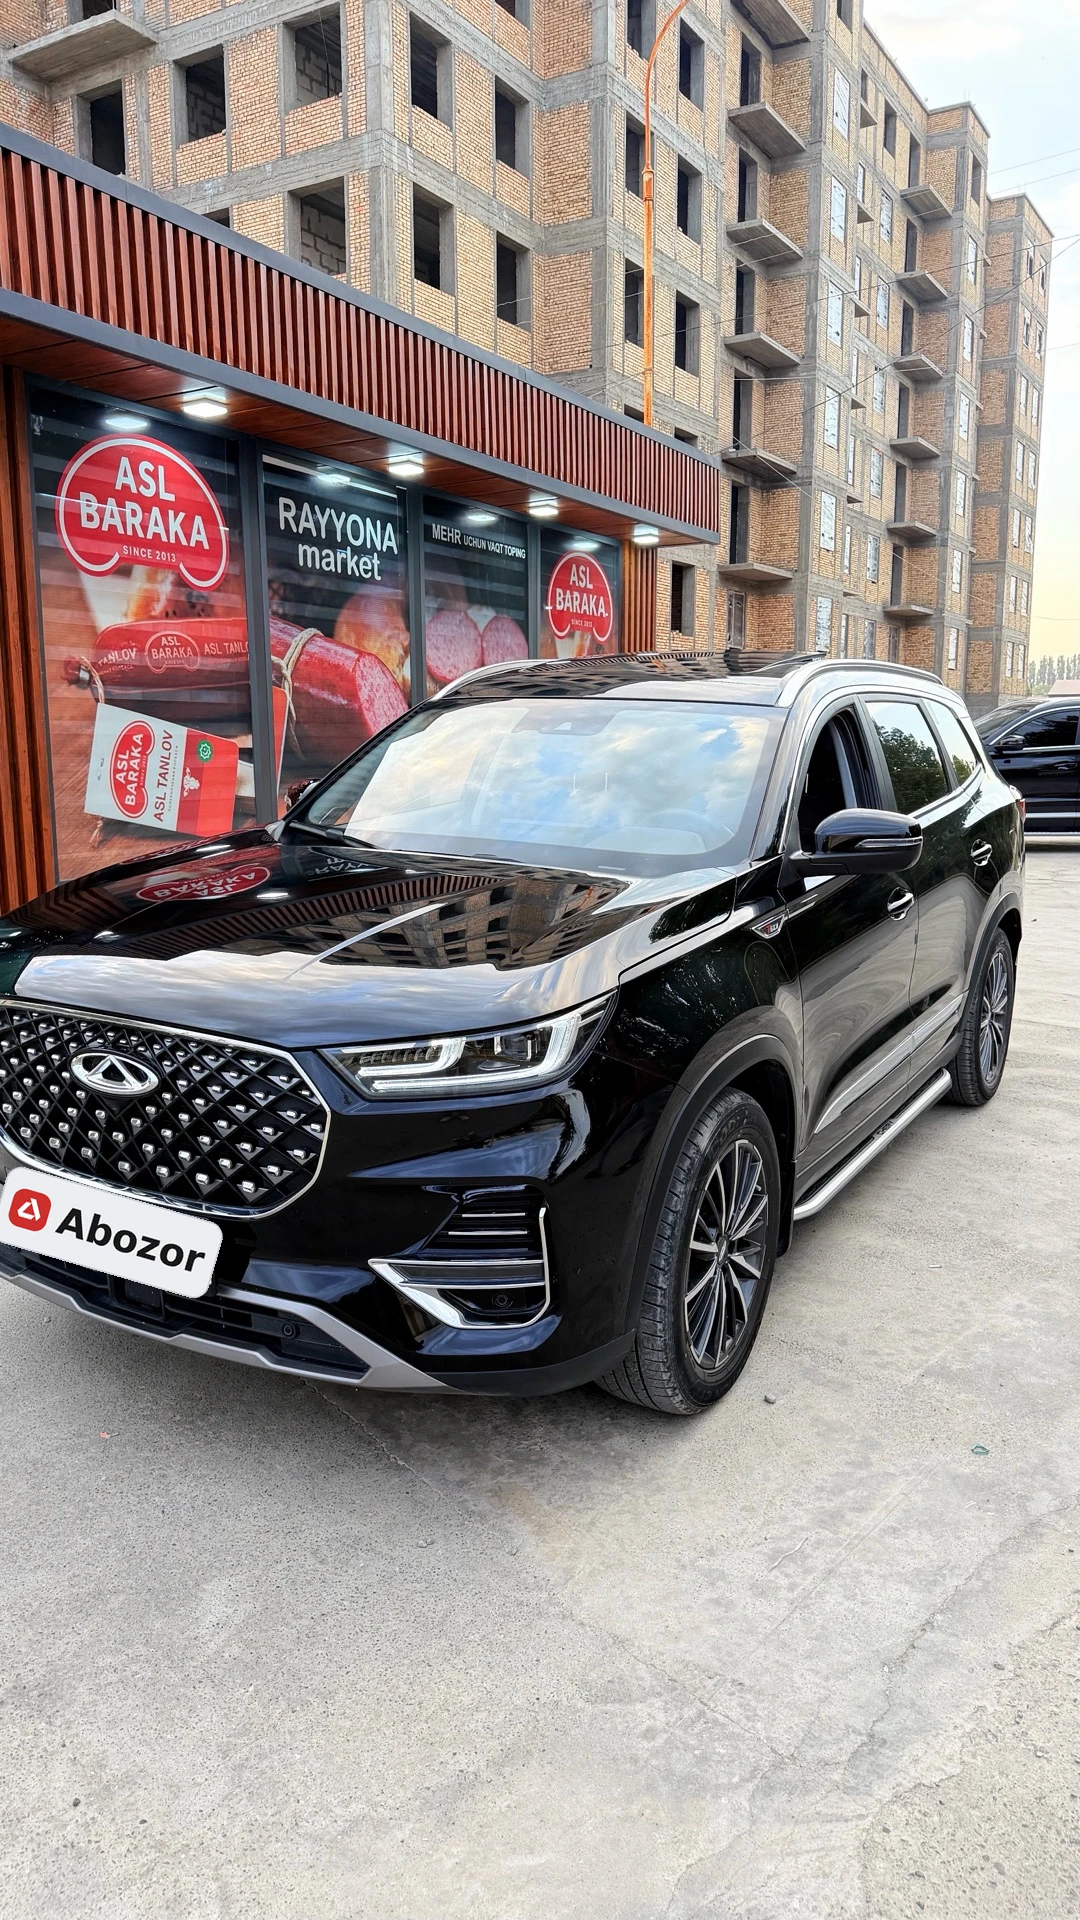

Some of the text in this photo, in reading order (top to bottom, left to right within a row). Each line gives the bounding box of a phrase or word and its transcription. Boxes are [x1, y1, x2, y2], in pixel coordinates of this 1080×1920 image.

[115, 456, 175, 502] ASL
[79, 491, 210, 550] BARAKA
[278, 497, 398, 555] RAYYONA
[123, 545, 176, 563] SINCE 2013
[432, 523, 526, 559] MEHR UCHUN VAQT TOPING
[298, 543, 382, 580] market
[570, 563, 594, 589] ASL
[556, 587, 606, 618] BARAKA
[98, 647, 137, 667] TANLOV
[151, 647, 194, 659] BARAKA
[161, 636, 181, 646] ASL
[204, 643, 222, 655] ASL
[115, 749, 130, 784] ASL
[125, 733, 144, 806] BARAKA
[154, 730, 173, 822] ASL TANLOV
